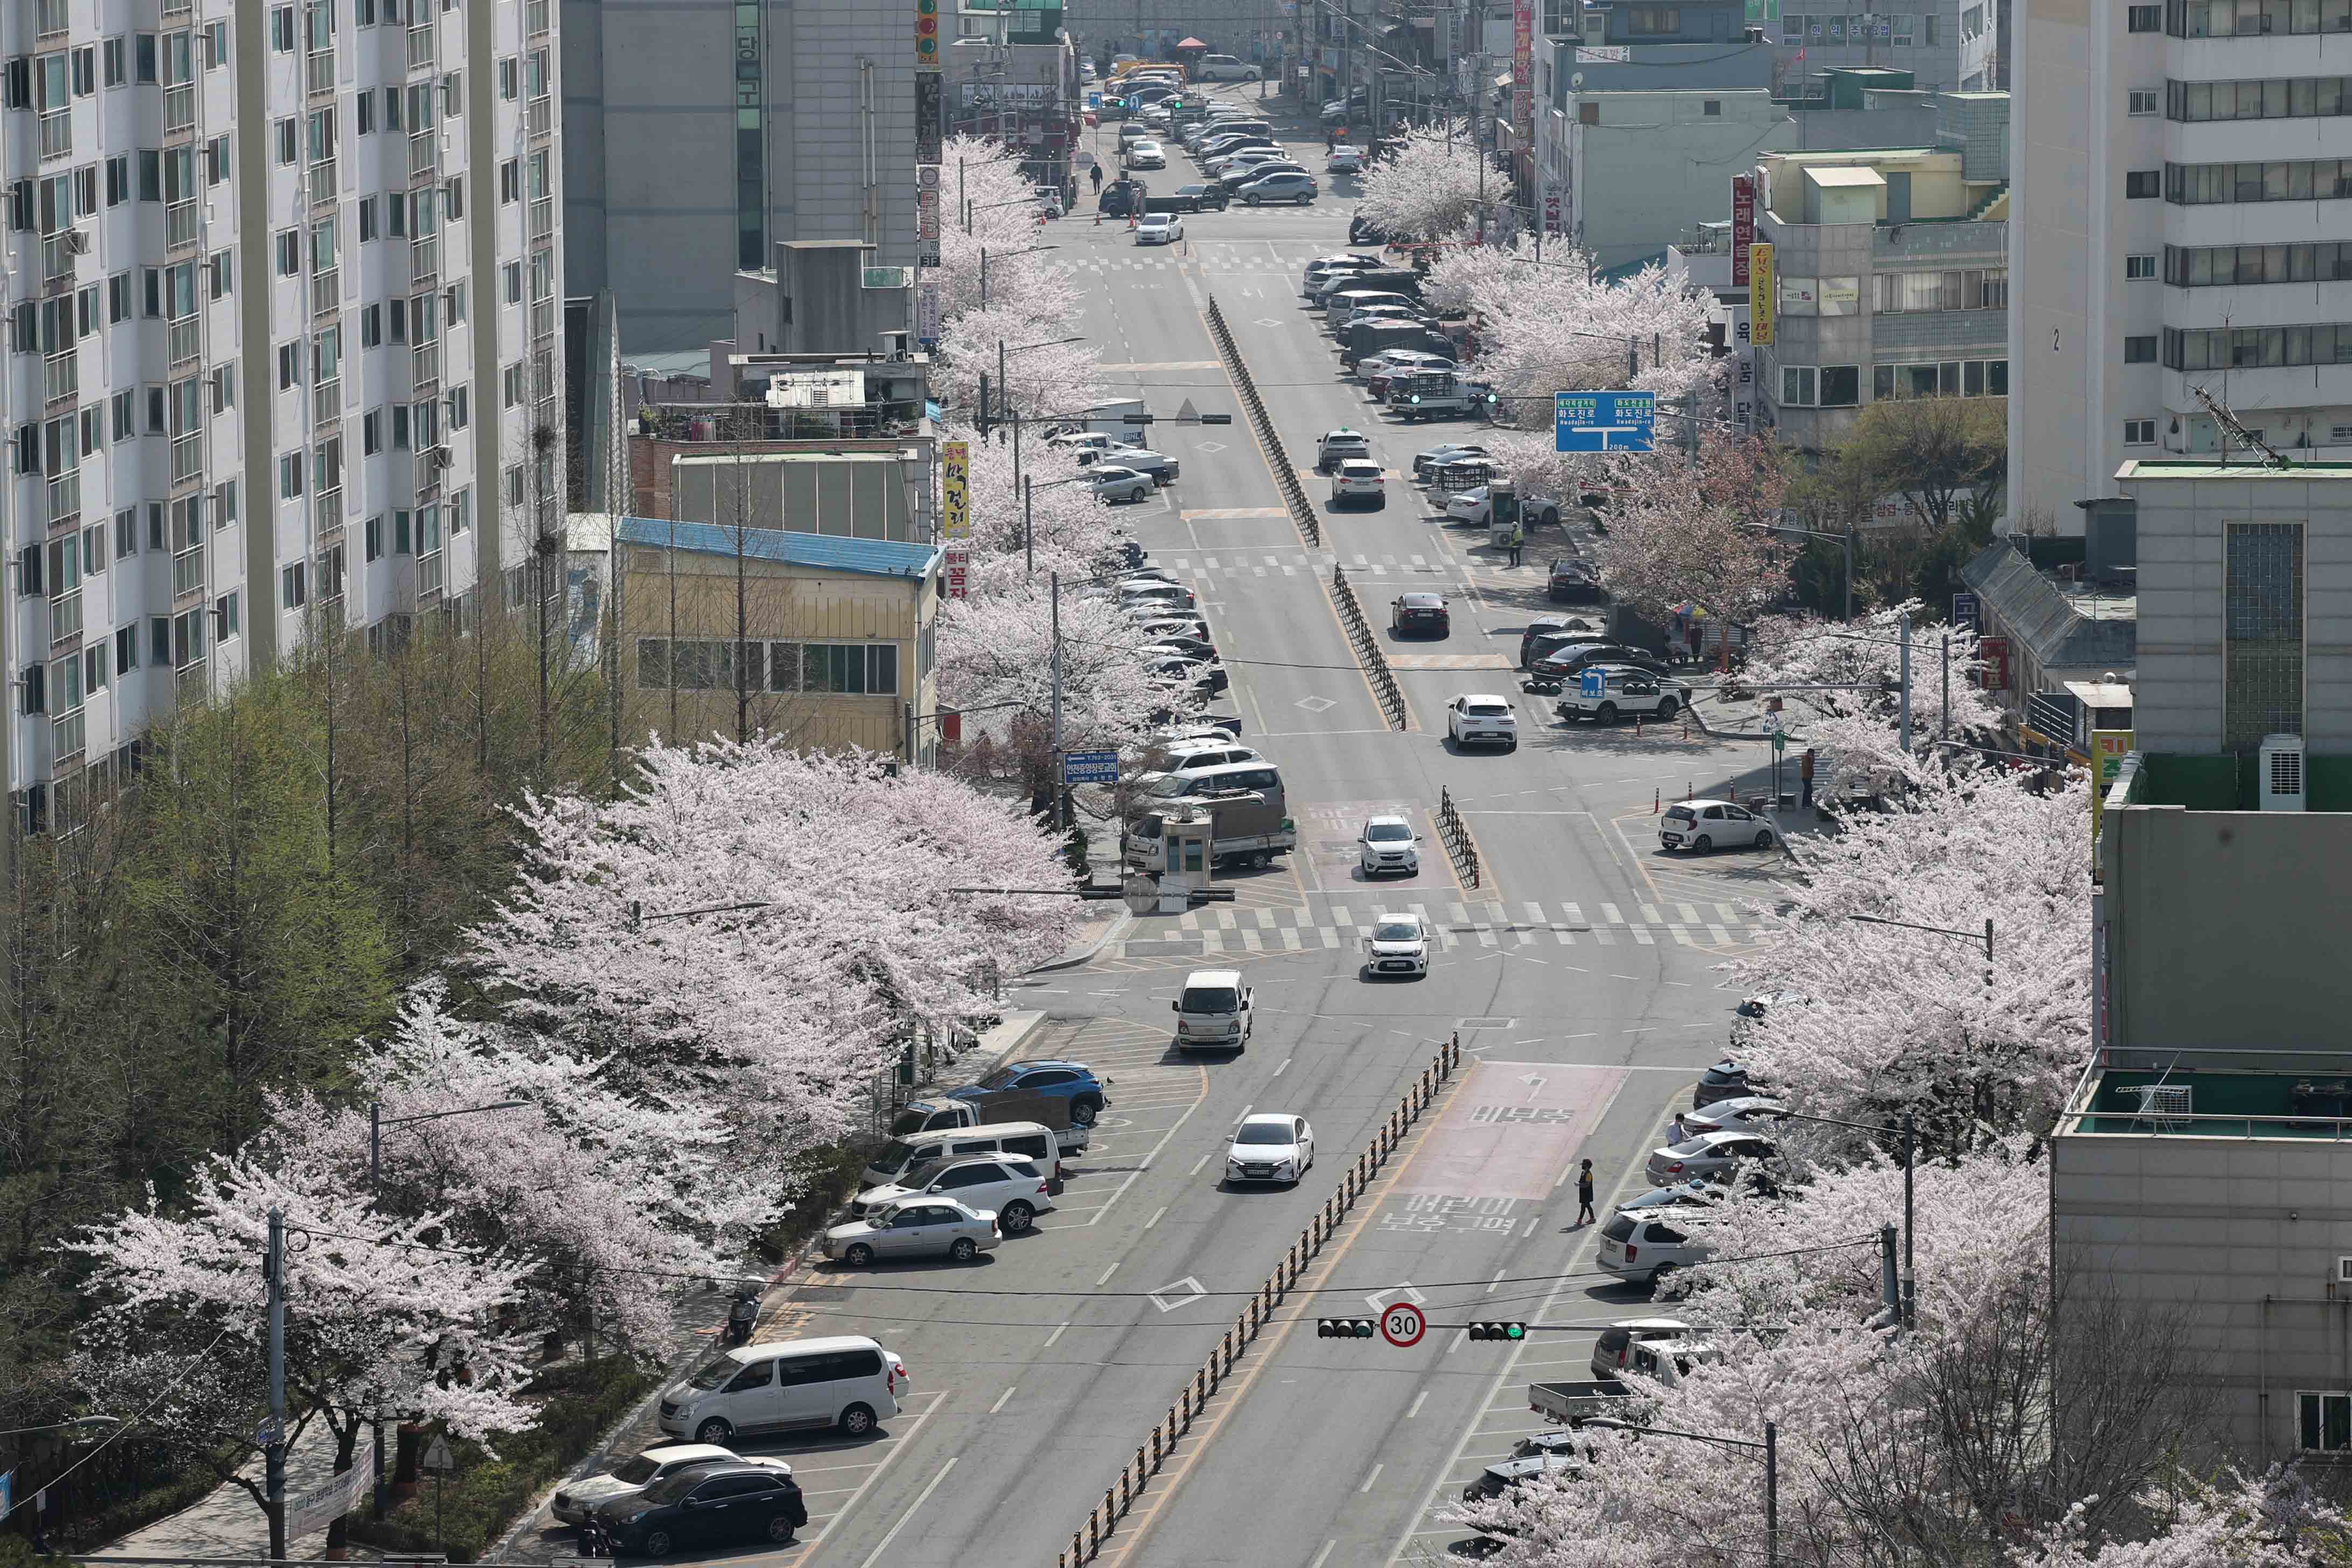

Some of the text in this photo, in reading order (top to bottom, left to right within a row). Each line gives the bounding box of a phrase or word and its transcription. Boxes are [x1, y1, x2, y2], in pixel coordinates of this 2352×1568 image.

[1850, 25, 1889, 37] 추요법
[1735, 190, 1751, 276] 노래연습장
[922, 257, 938, 267] 3F
[1755, 248, 1769, 276] EMS
[2054, 328, 2059, 351] 2
[1616, 400, 1650, 408] 화도진공원
[1558, 409, 1595, 419] 화도진로
[1615, 409, 1652, 418] 화도진로
[946, 463, 967, 524] 막걸리
[1067, 762, 1117, 775] 인천중앙장로교회
[1469, 1107, 1576, 1124] 비보호
[1403, 1194, 1517, 1215] 어린이
[1376, 1213, 1517, 1235] 보호구역
[1390, 1316, 1416, 1335] 30
